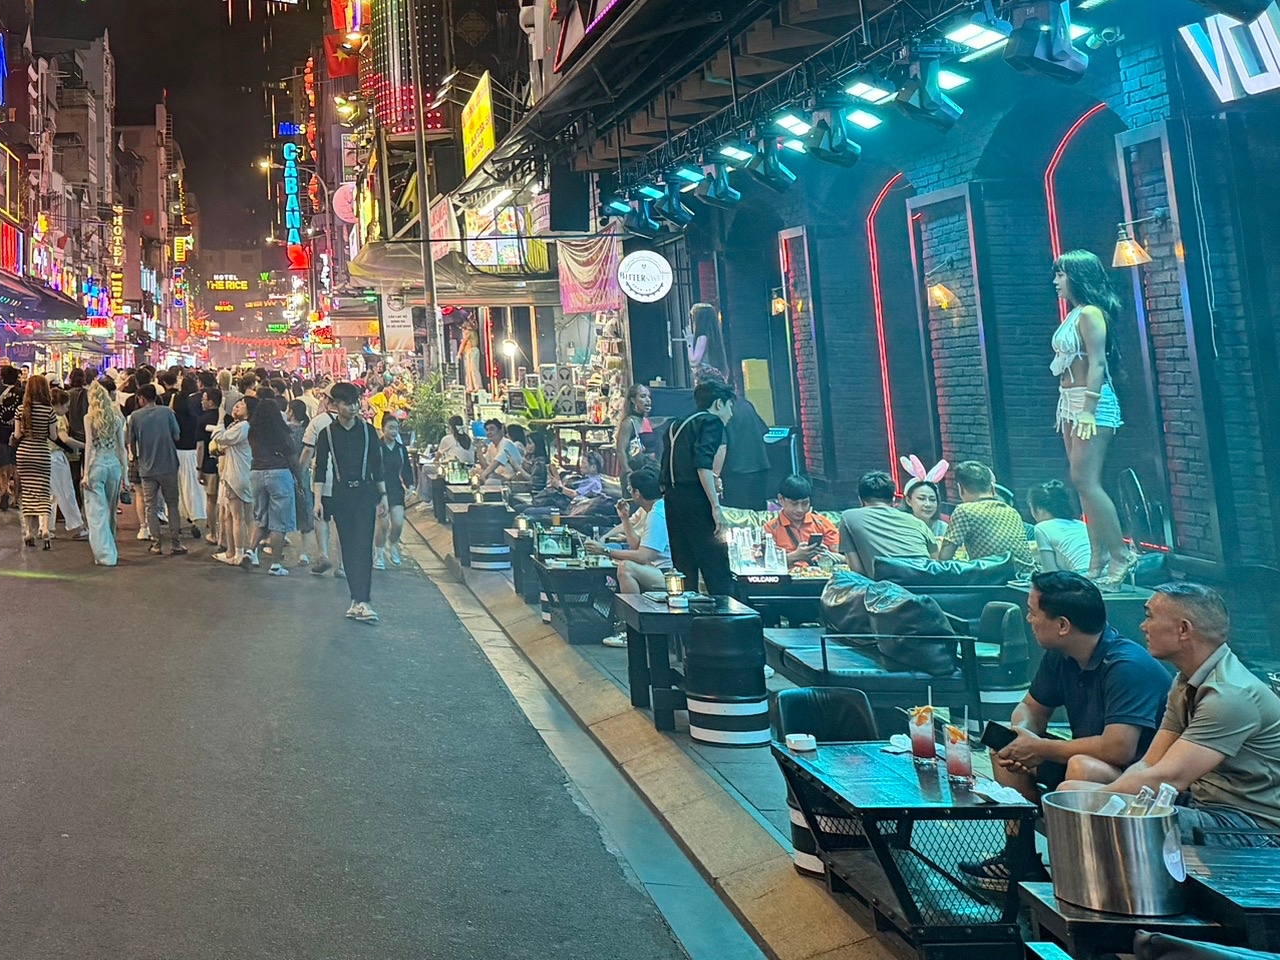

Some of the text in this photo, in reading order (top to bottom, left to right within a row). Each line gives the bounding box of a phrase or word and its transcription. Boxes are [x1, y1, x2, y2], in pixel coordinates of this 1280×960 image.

[283, 142, 301, 244] CABANA
[112, 215, 123, 267] HOTEL
[206, 280, 249, 290] THE RICE
